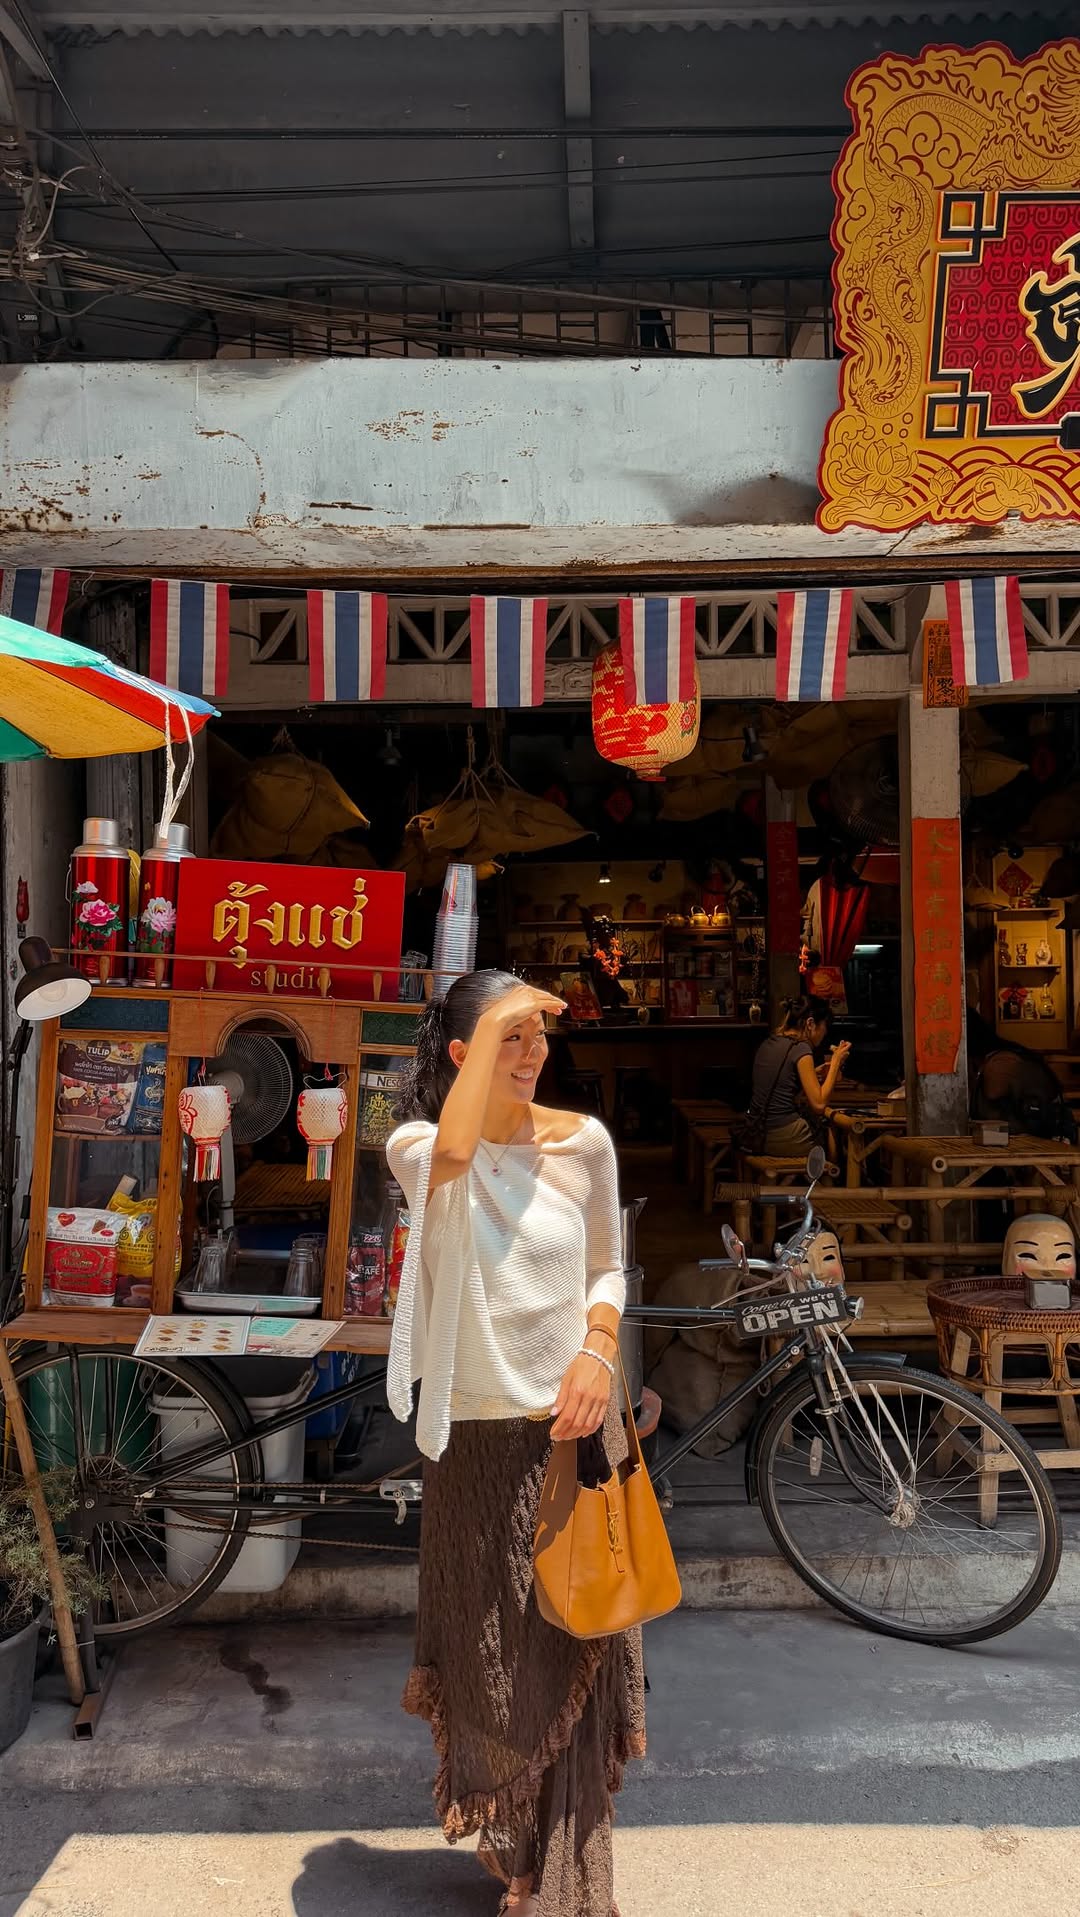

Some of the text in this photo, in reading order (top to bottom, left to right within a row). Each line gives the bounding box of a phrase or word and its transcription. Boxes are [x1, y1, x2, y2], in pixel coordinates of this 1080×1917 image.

[87, 1046, 110, 1056] TULIP
[741, 1302, 780, 1316] Come
[799, 1292, 835, 1304] we're
[742, 1299, 840, 1333] OPEN
